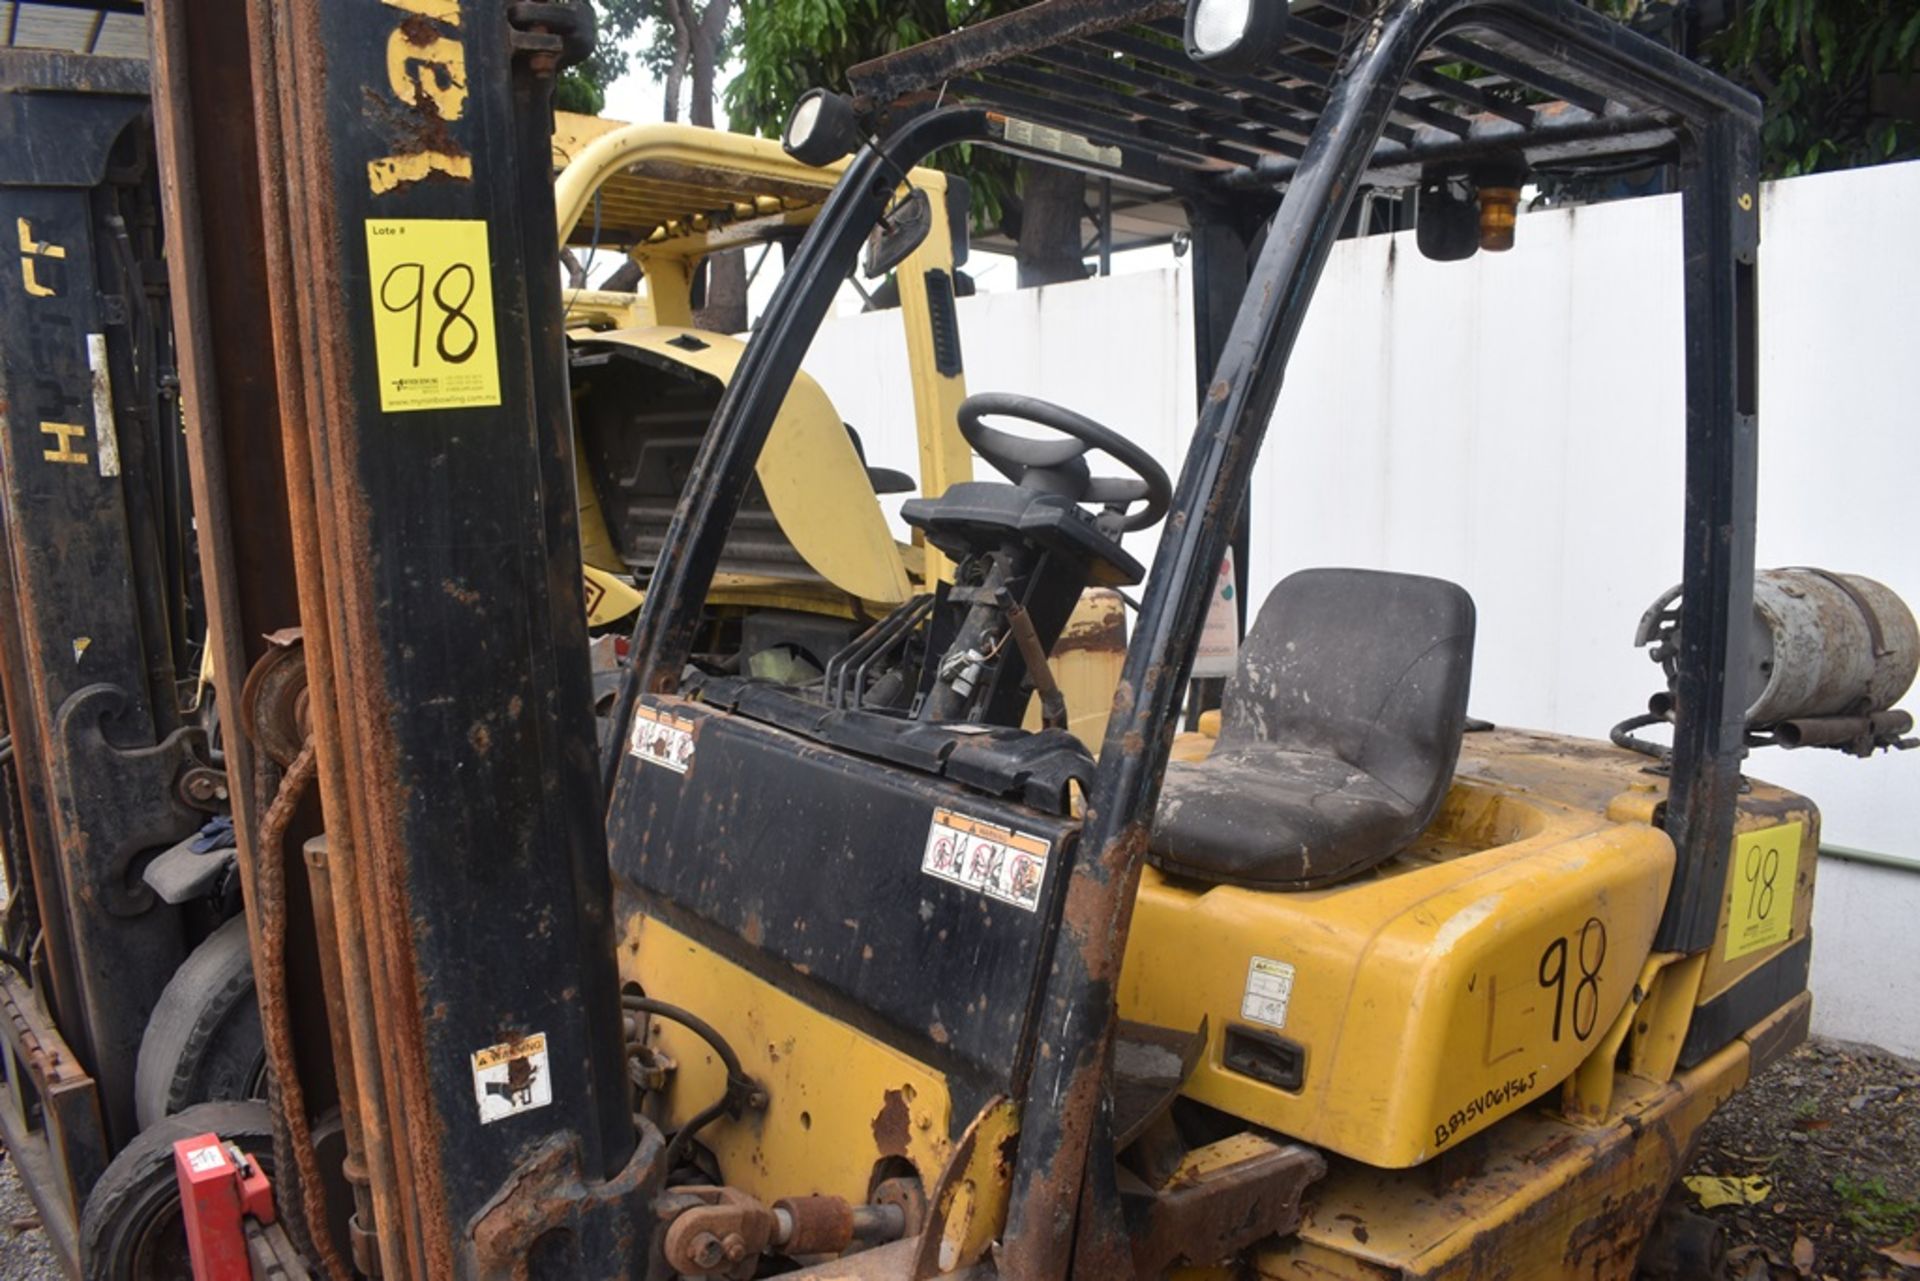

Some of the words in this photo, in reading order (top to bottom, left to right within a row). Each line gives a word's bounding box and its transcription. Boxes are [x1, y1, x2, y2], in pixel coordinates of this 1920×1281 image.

[372, 226, 396, 235] Lote
[380, 262, 479, 368] 98
[1745, 845, 1779, 919] 98
